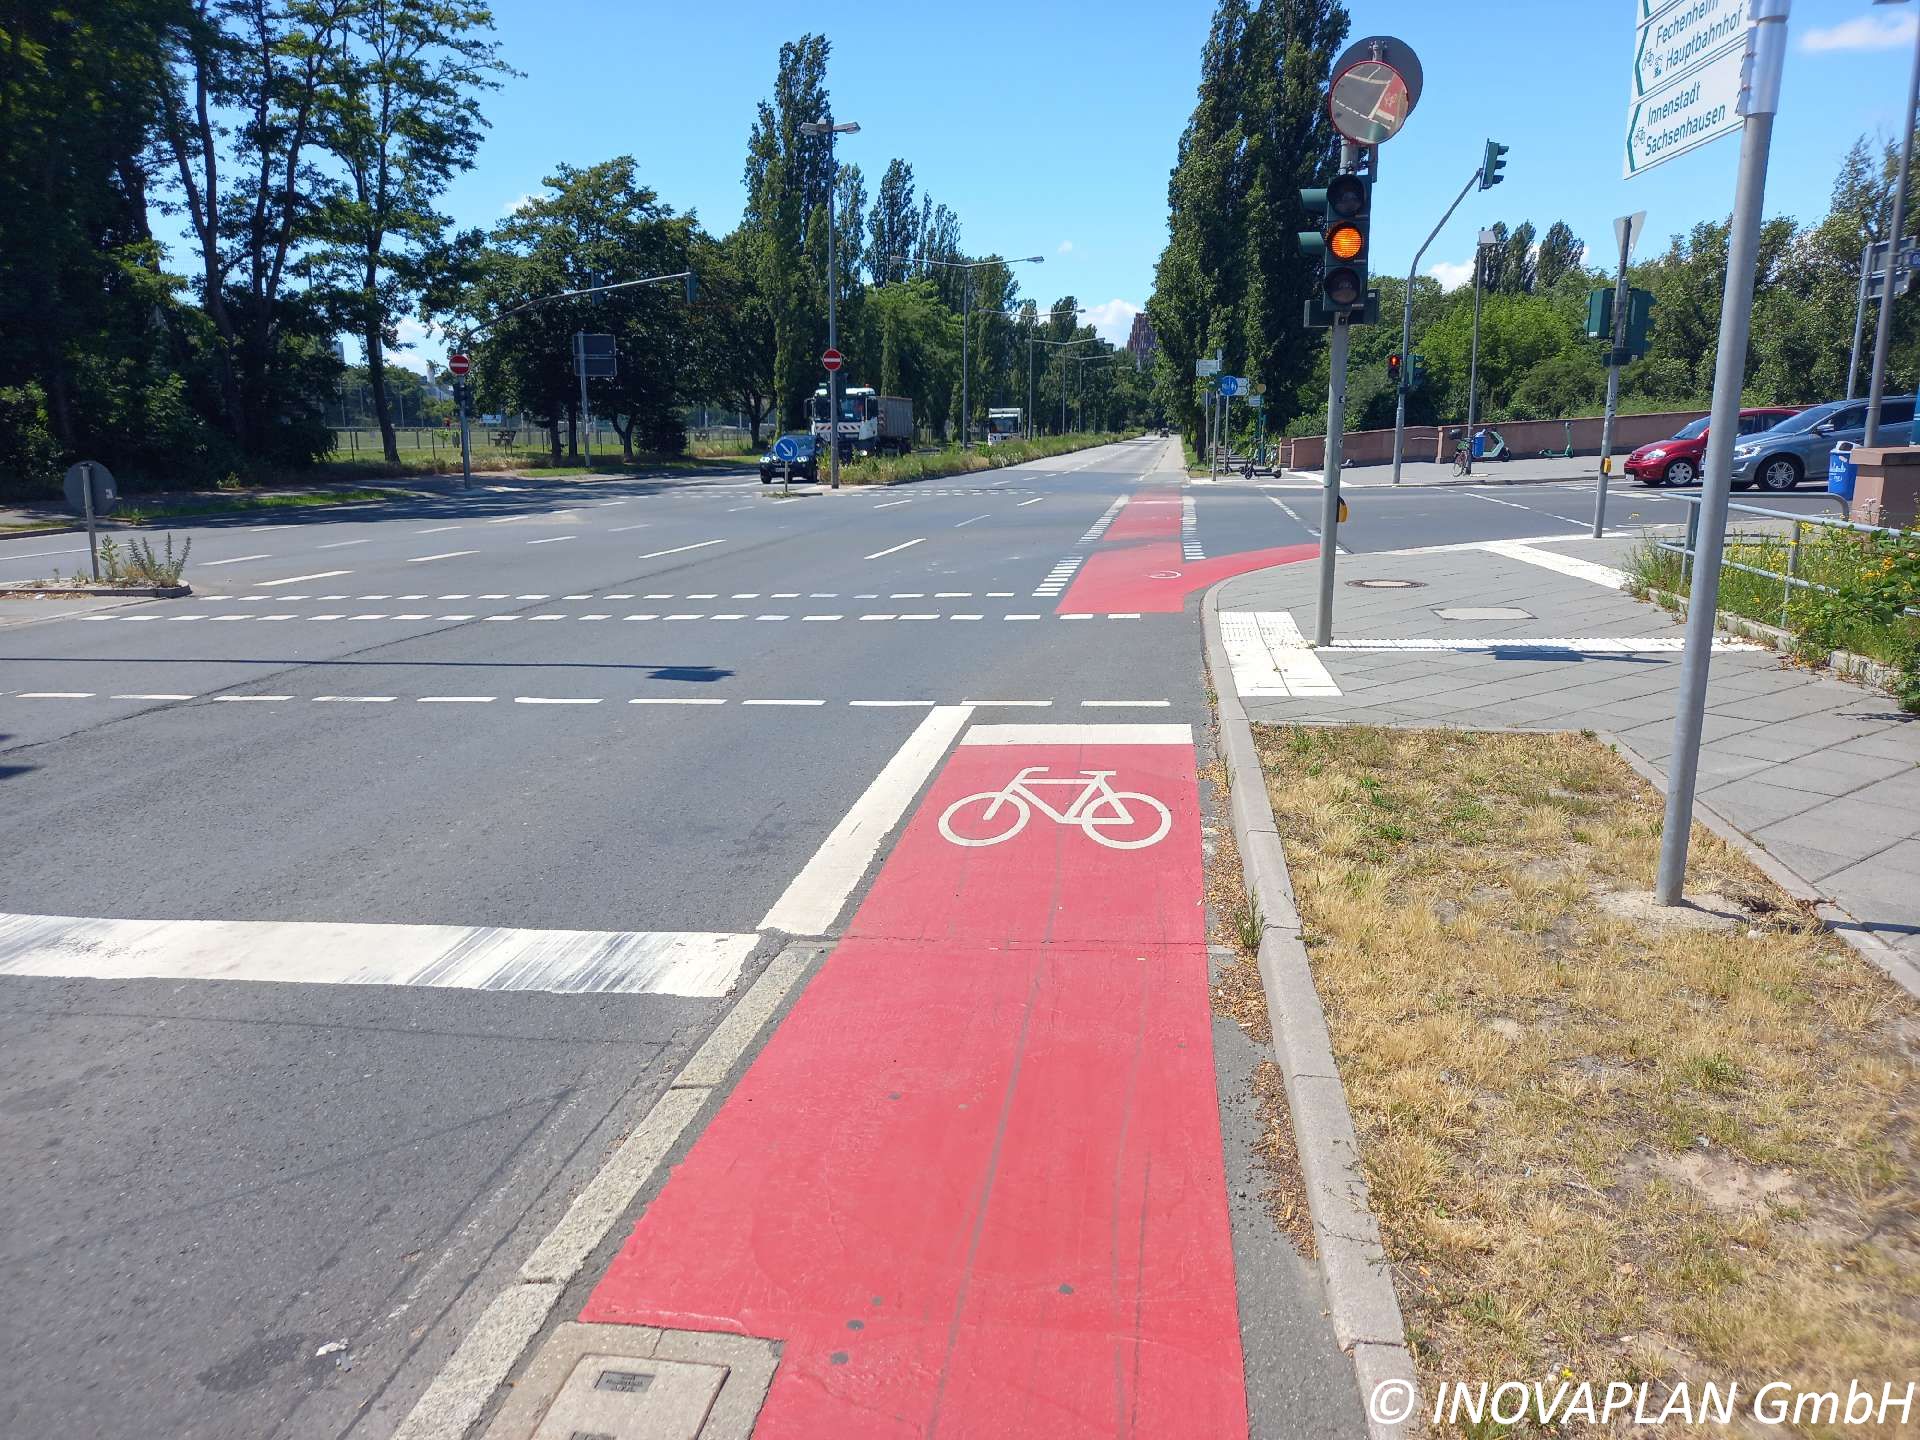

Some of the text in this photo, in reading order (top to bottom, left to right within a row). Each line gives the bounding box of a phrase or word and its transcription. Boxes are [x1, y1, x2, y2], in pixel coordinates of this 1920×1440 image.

[1665, 4, 1743, 71] Hauptbahnhof
[1647, 80, 1701, 127] Innenstadt
[1645, 104, 1726, 157] Sachsenhausen
